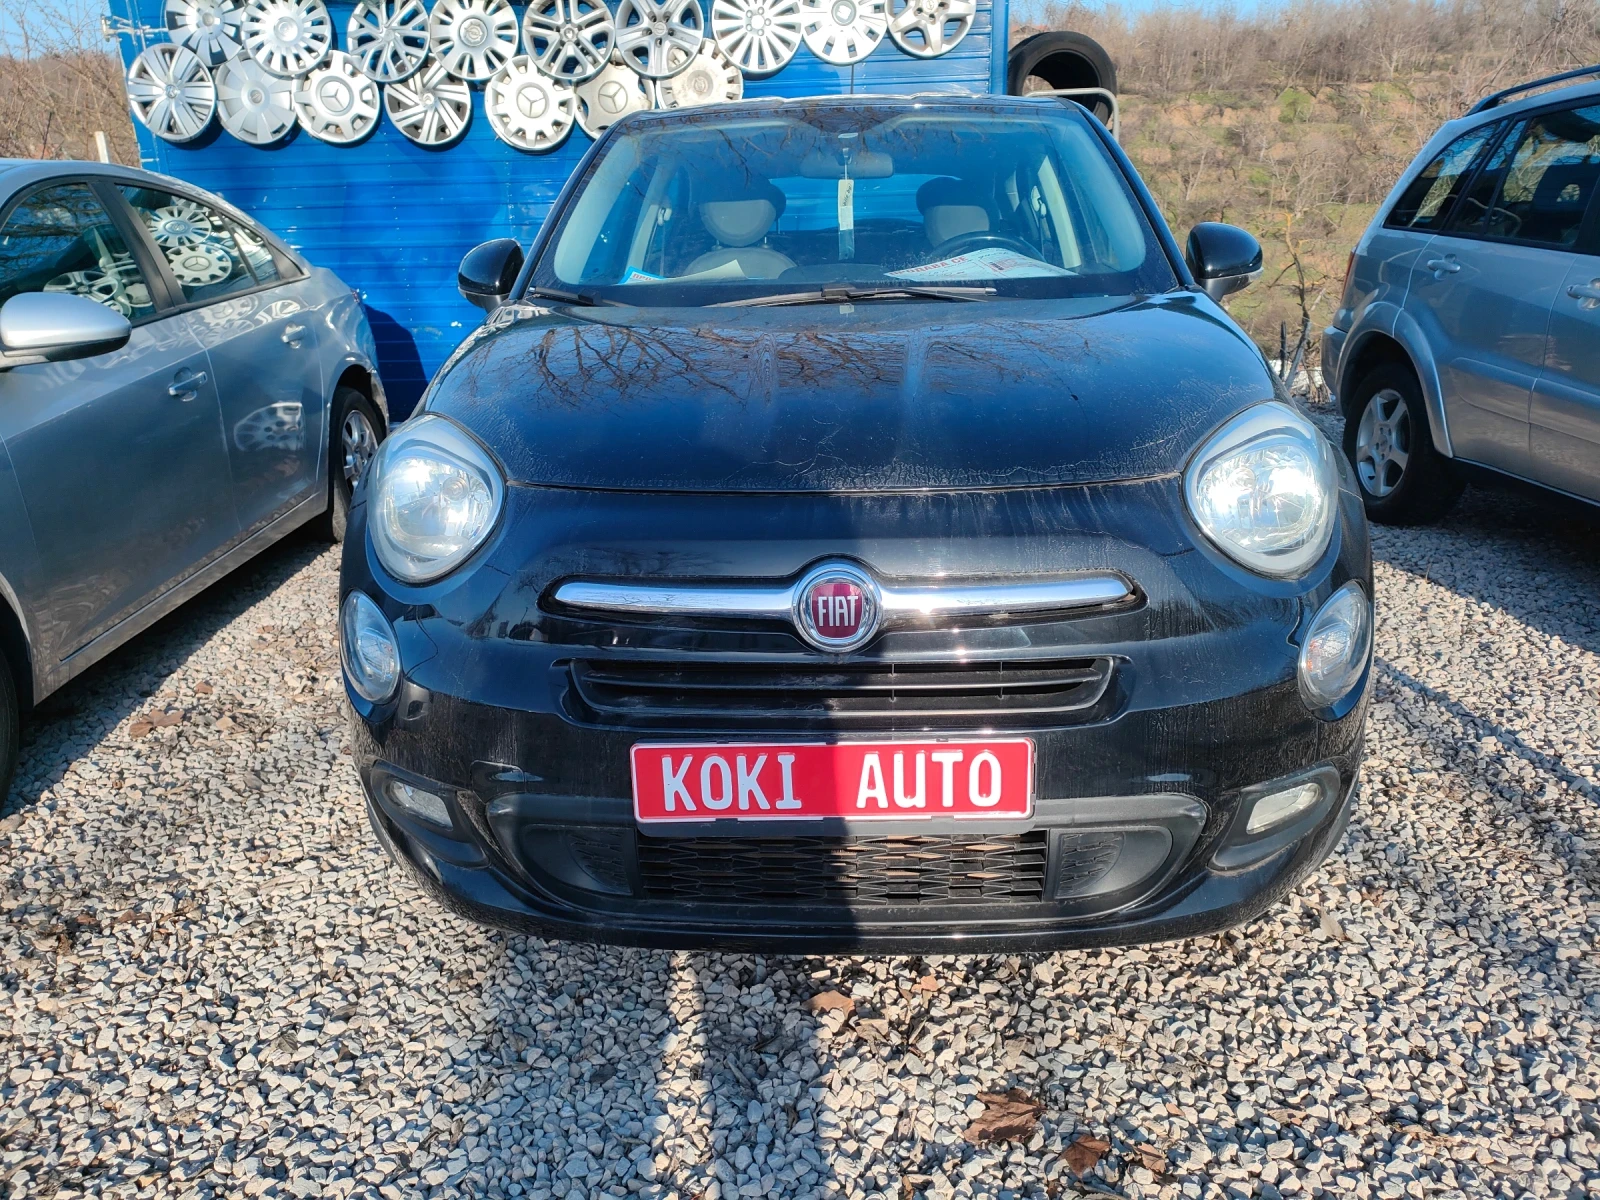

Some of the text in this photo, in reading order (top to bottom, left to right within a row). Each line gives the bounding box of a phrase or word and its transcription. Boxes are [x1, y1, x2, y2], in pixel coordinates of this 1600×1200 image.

[818, 595, 858, 627] FIAT
[661, 751, 1002, 812] KOKI AUTO
